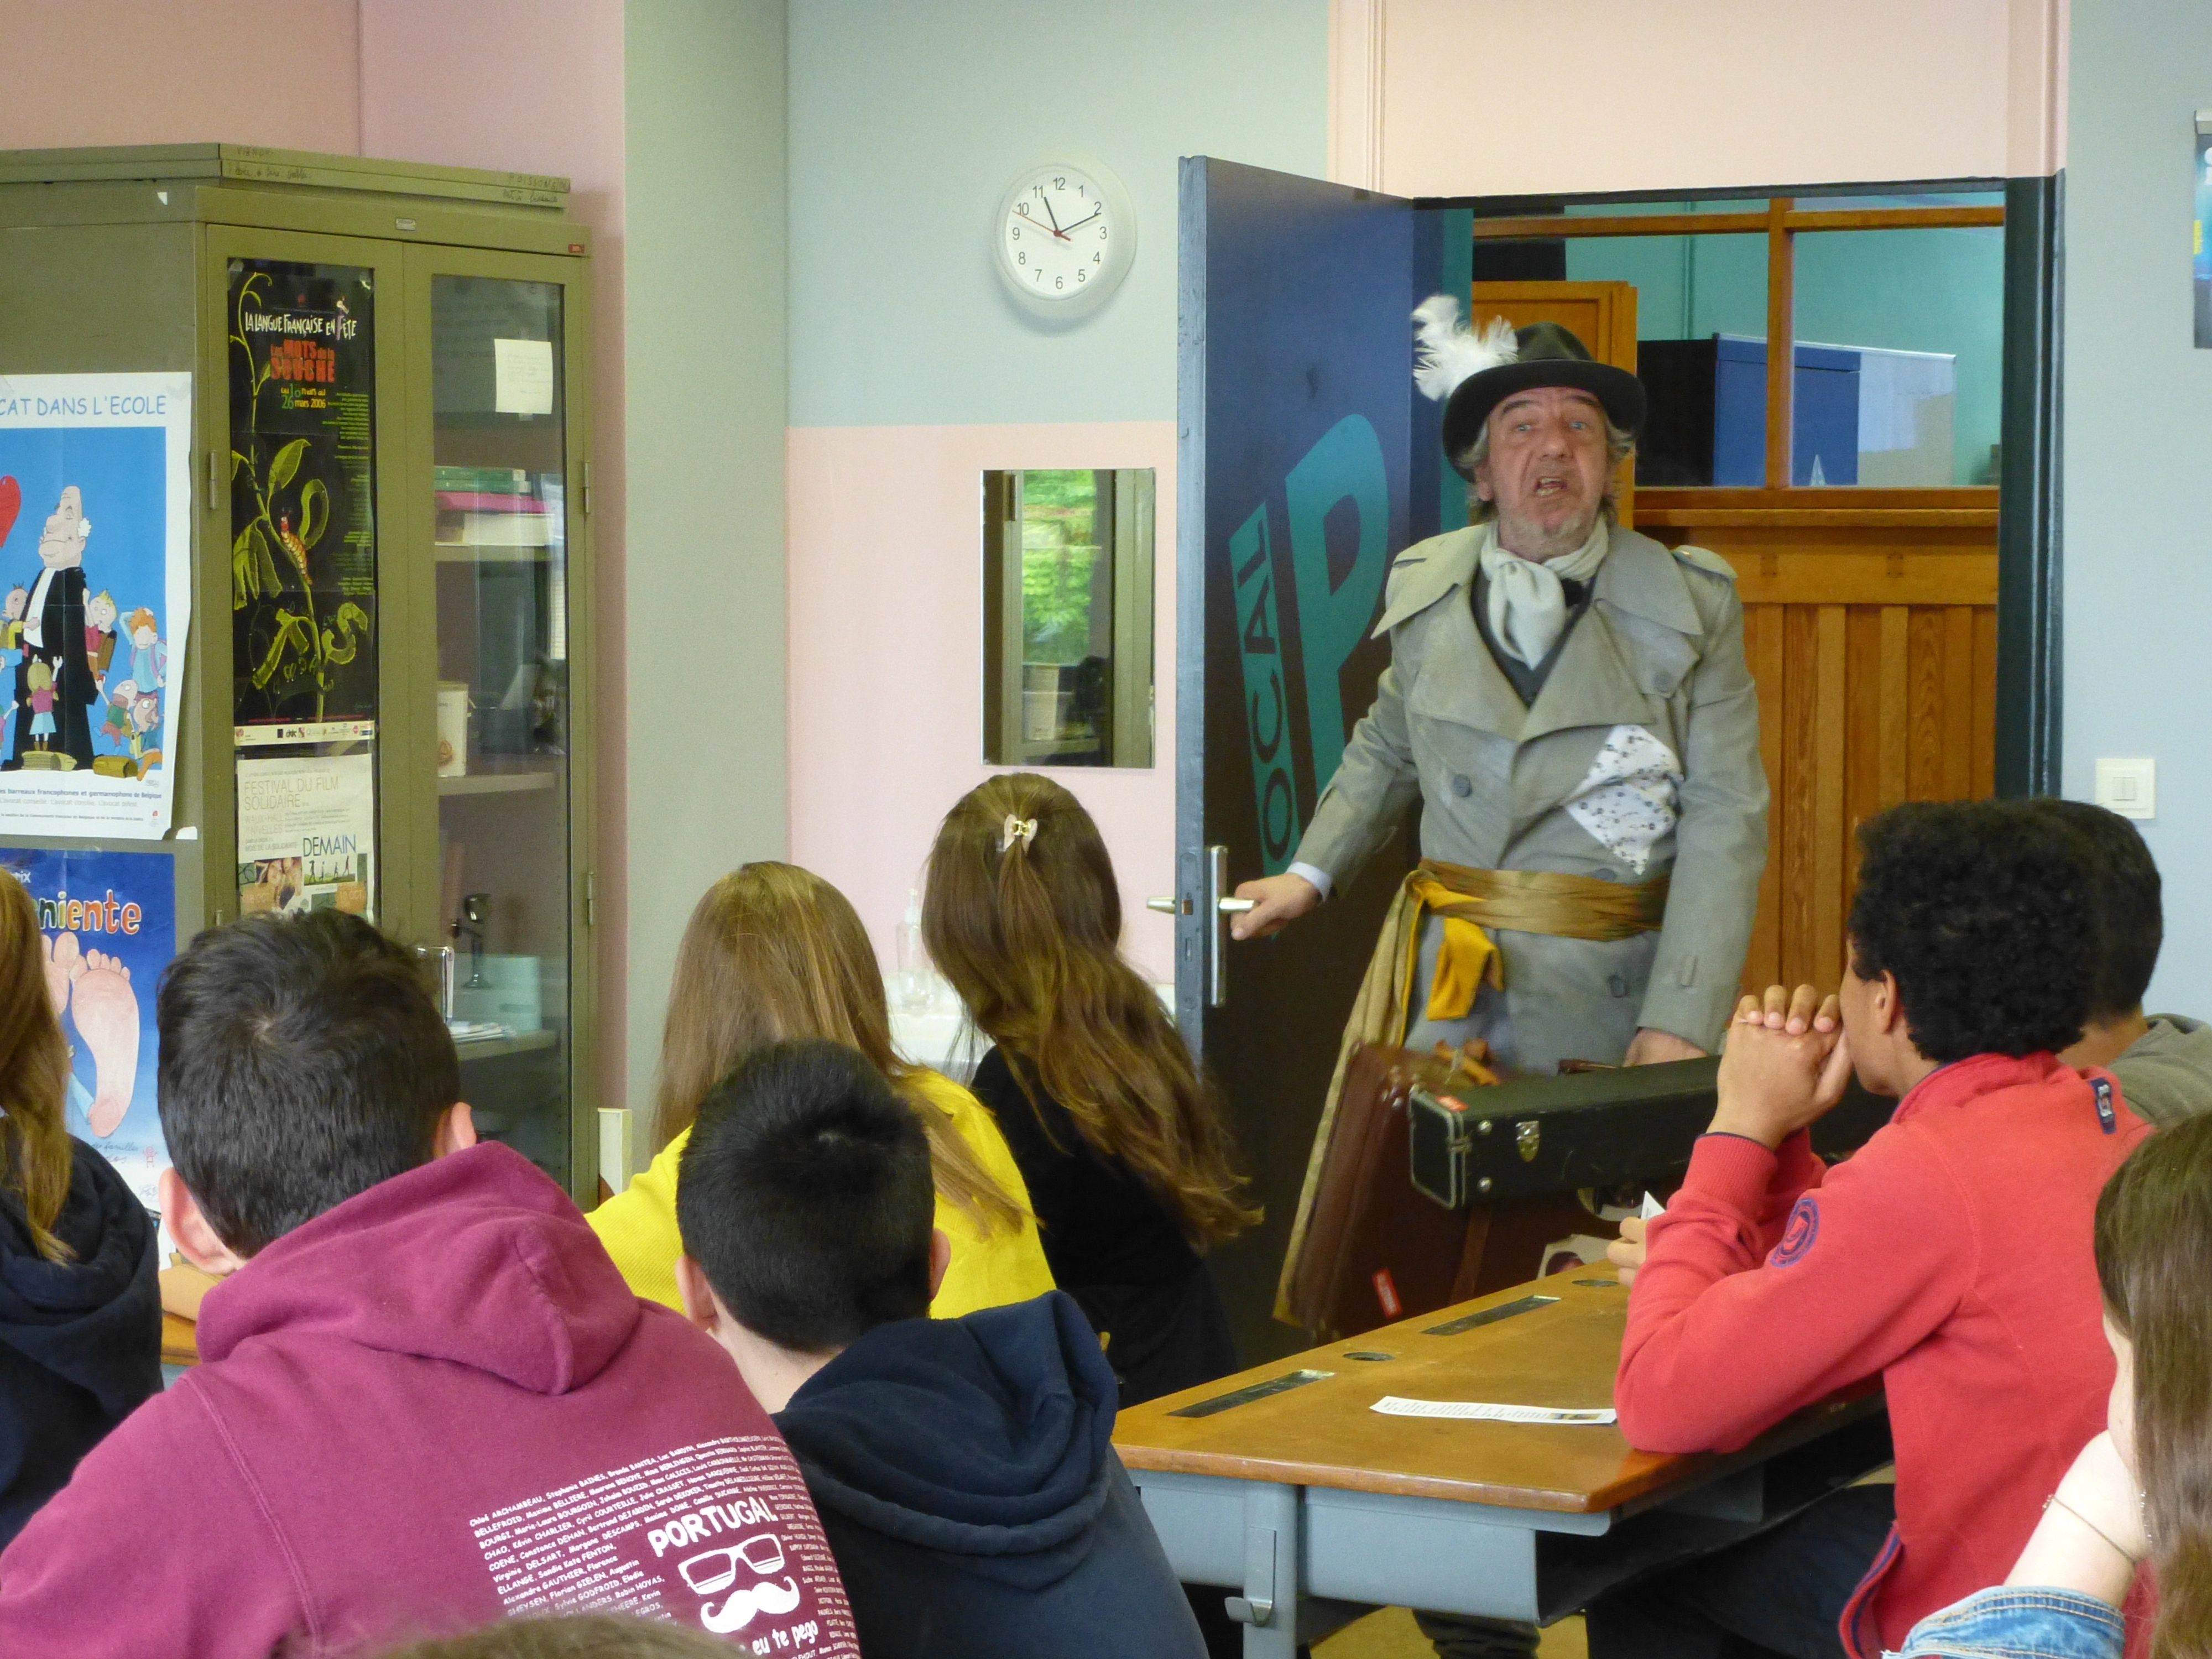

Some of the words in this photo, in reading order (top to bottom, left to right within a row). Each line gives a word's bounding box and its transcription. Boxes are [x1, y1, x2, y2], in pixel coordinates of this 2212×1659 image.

[1053, 177, 1066, 190] 12
[1032, 185, 1044, 198] 11
[1078, 185, 1084, 198] 1
[1017, 202, 1029, 216] 10
[1094, 201, 1102, 215] 2
[1013, 227, 1020, 240] 9
[1099, 226, 1107, 239] 3
[1018, 252, 1026, 265] 8
[1093, 251, 1100, 264] 4
[1035, 269, 1042, 282] 7
[1055, 276, 1063, 289] 6
[1078, 269, 1086, 282] 5
[246, 311, 254, 332] LA
[255, 314, 283, 332] LANGUE
[326, 319, 335, 336] EN
[270, 357, 335, 383] SOUCHE
[37, 397, 87, 416] DANS
[93, 395, 166, 415] L'ECOLE
[281, 394, 294, 409] 26
[310, 398, 326, 408] 2006
[1237, 519, 1293, 863] OCAL
[244, 779, 294, 795] FESTIVAL
[298, 778, 313, 792] DU
[316, 776, 339, 791] FILM
[244, 794, 301, 811] SOLIDAIRE
[303, 834, 356, 857] DEMAIN
[32, 888, 142, 935] niente
[576, 1514, 593, 1526] Cyril
[648, 1496, 778, 1557] PORTUGAL
[519, 1541, 557, 1559] Constance
[587, 1516, 618, 1533] Bertrand
[538, 1564, 563, 1578] Sandie
[563, 1557, 581, 1568] Kate
[493, 1568, 522, 1583] Virginie
[503, 1586, 541, 1605] Alexandre
[586, 1556, 618, 1572] Florence
[549, 1585, 576, 1599] Florian
[609, 1559, 640, 1575] Augustin
[622, 1571, 645, 1584] Elodie
[614, 1587, 635, 1599] Robin
[641, 1590, 661, 1601] Kevin
[752, 1637, 770, 1656] eu
[772, 1629, 790, 1649] te
[791, 1620, 818, 1649] pego
